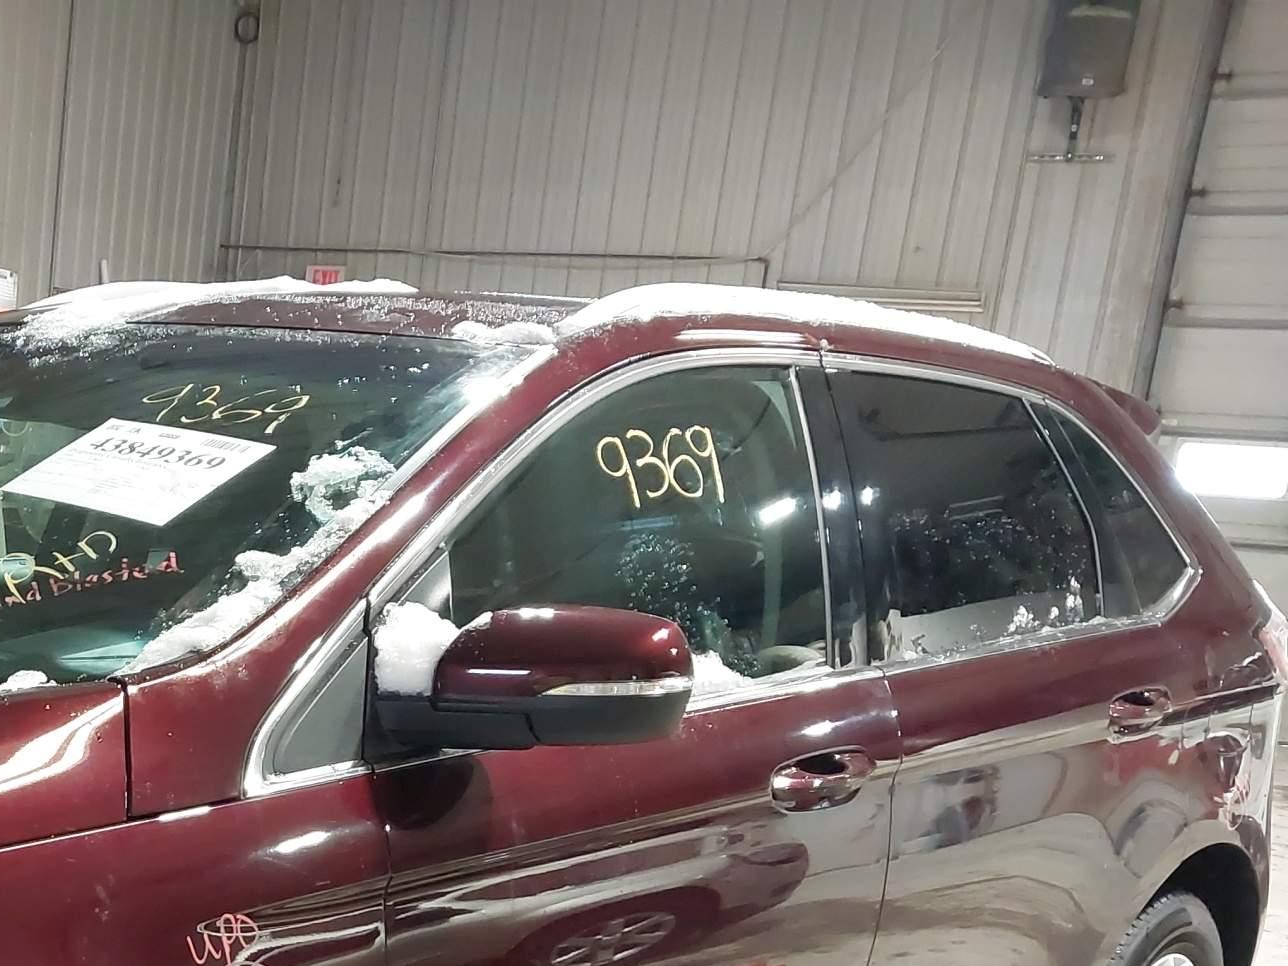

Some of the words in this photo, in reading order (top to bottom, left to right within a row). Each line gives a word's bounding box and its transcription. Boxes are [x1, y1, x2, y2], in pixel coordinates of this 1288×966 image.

[142, 383, 311, 434] 9369
[90, 436, 226, 470] 43849369
[596, 425, 725, 508] 9369
